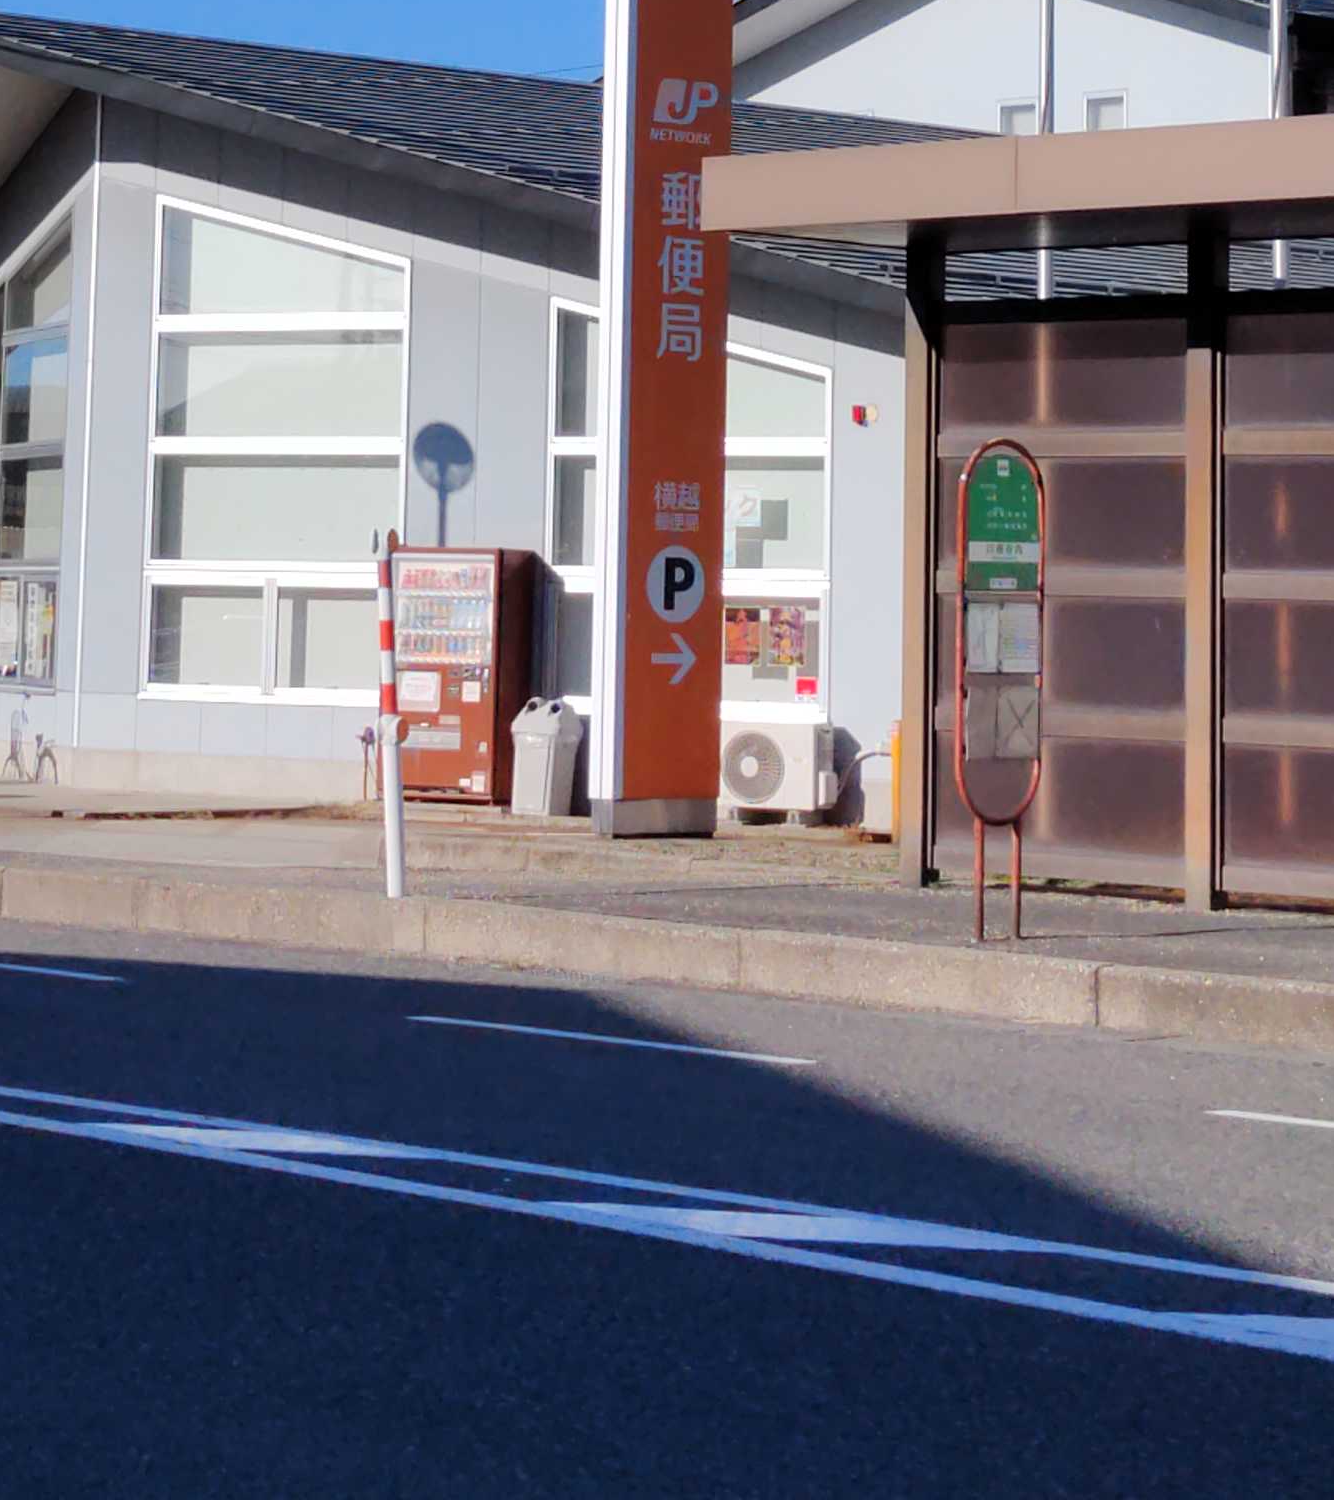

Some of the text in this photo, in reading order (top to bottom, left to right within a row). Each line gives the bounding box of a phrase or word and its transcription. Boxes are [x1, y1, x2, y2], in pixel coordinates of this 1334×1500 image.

[649, 126, 712, 146] NETWORK
[656, 171, 705, 363] 郵便局
[653, 480, 700, 511] 横越
[663, 556, 696, 611] P
